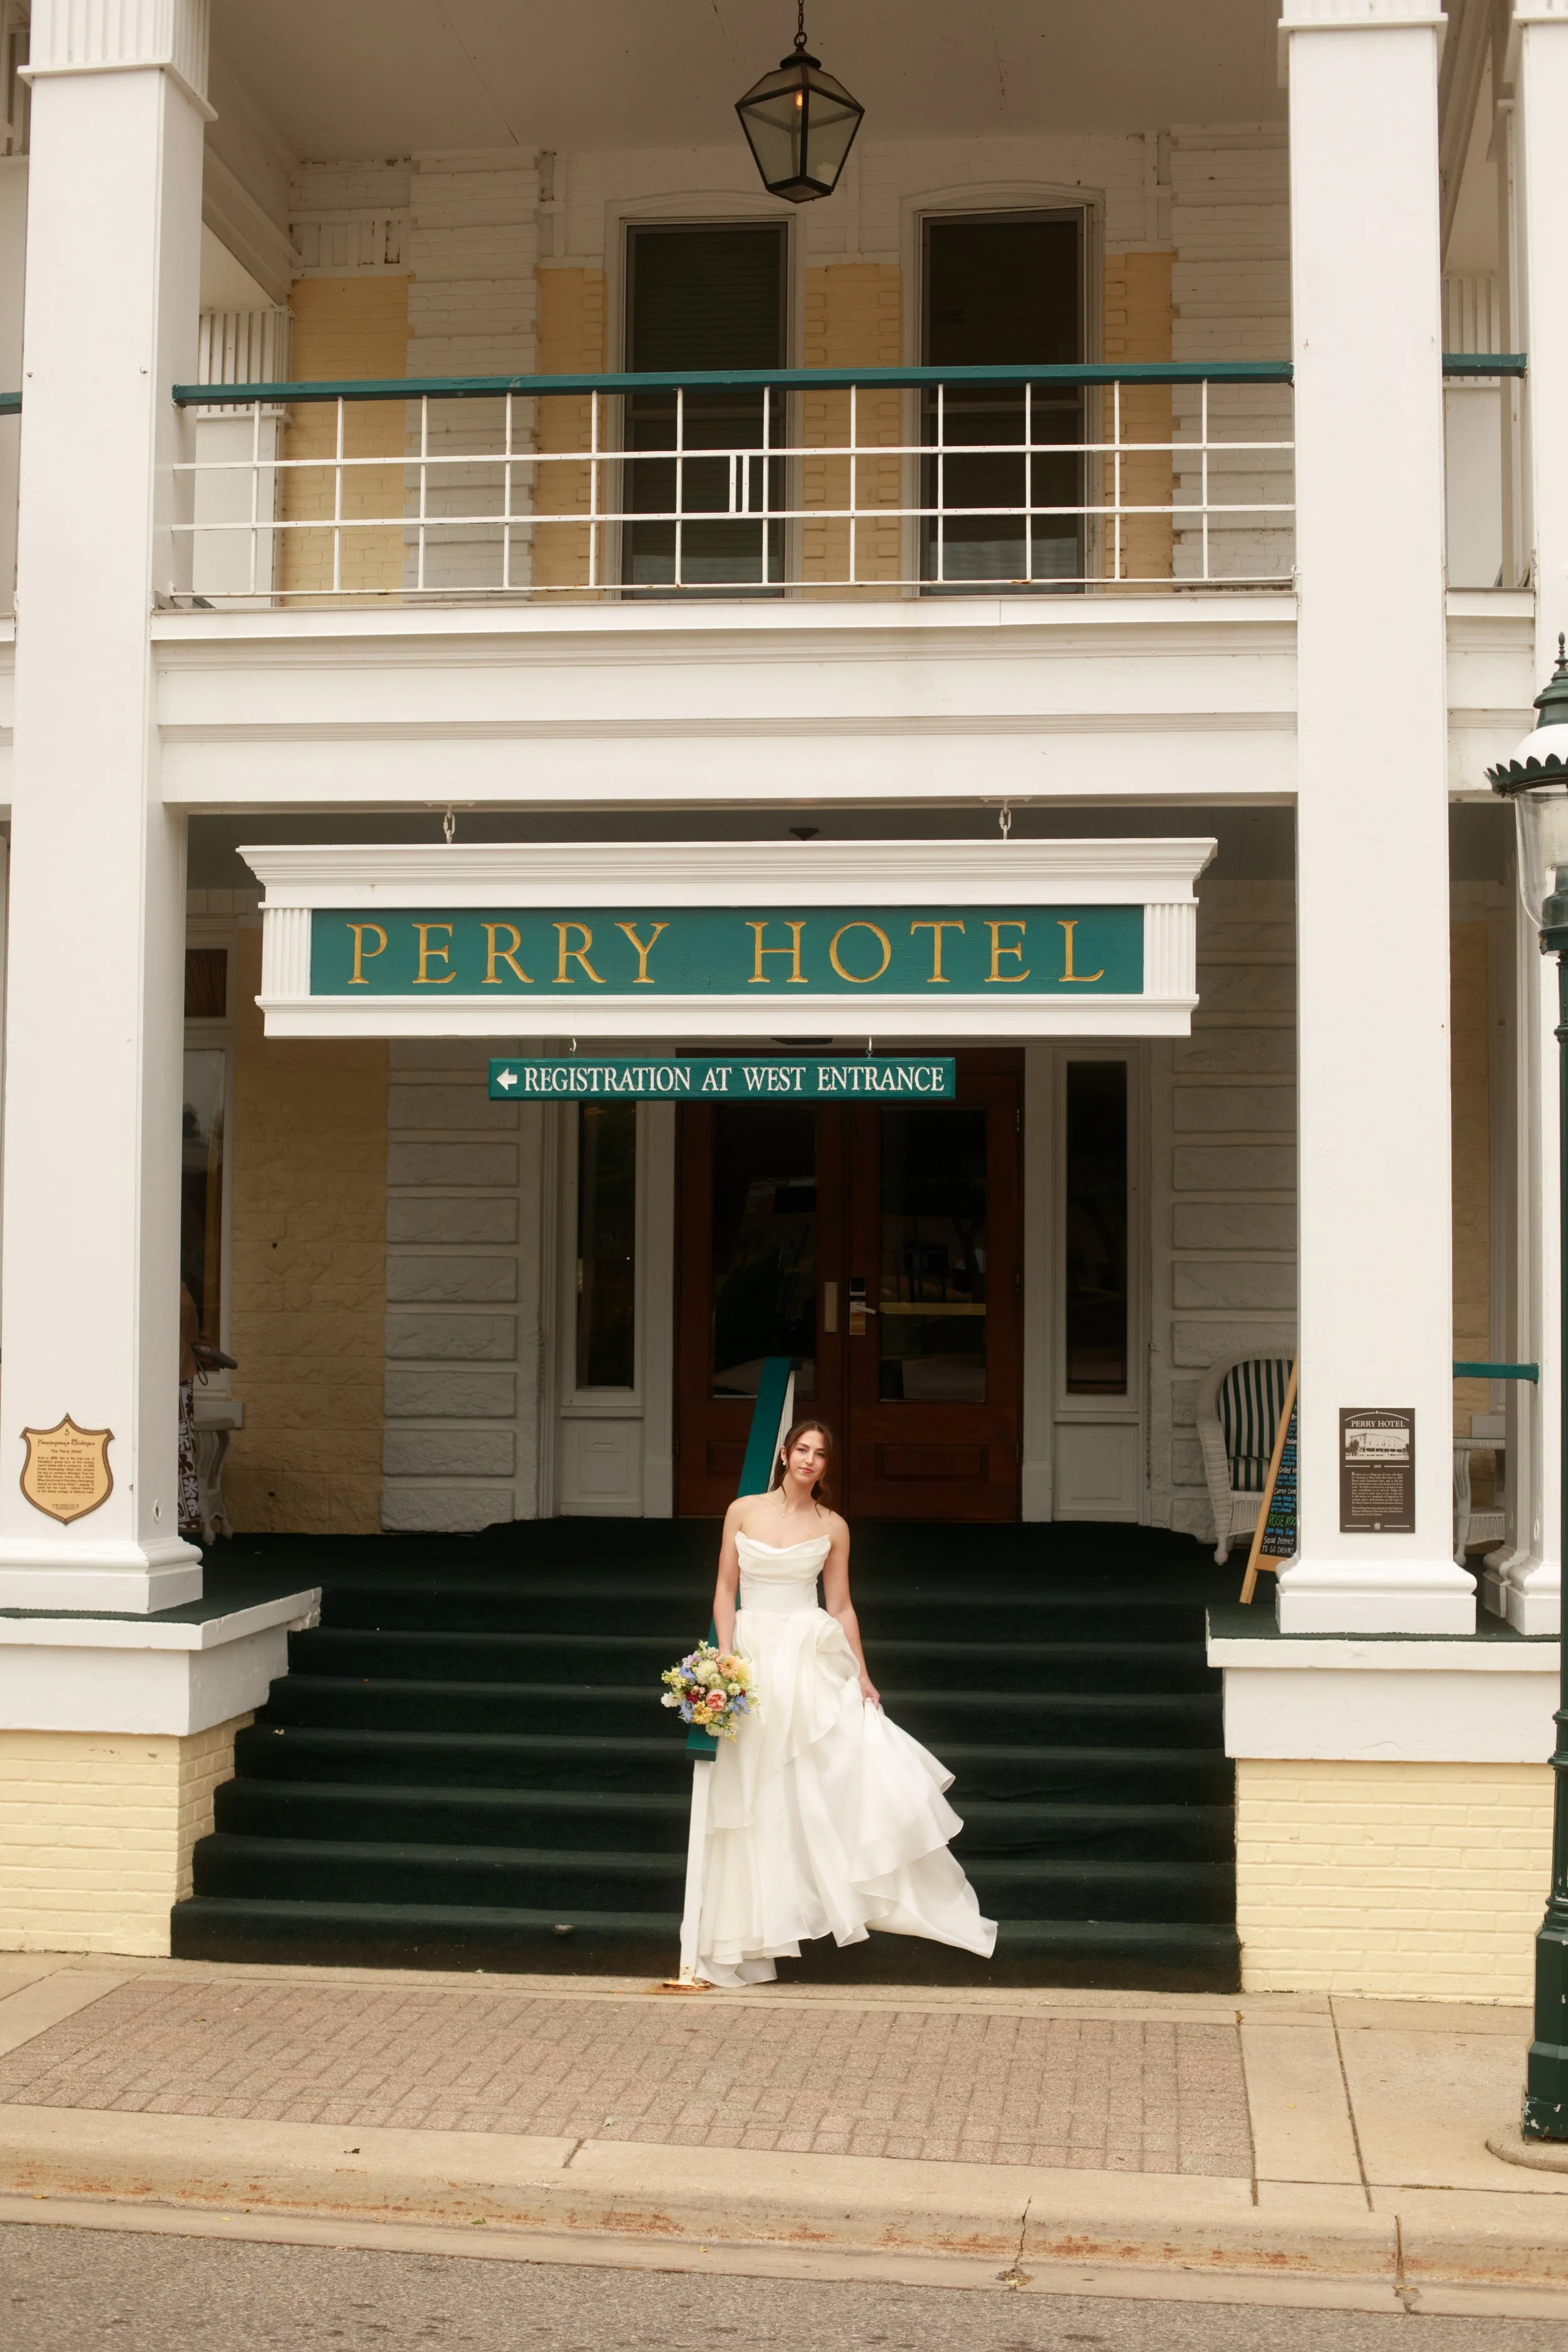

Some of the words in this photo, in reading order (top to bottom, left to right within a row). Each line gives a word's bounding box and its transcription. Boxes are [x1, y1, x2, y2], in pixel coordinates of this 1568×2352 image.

[346, 922, 670, 984] PERRY
[745, 920, 1104, 983] HOTEL
[524, 1067, 691, 1092] REGISTRATION
[701, 1067, 732, 1092] AT
[742, 1067, 806, 1092] WEST
[817, 1066, 945, 1092] ENTRANCE
[1268, 1514, 1285, 1527] ROSE
[1264, 1536, 1276, 1544] Social
[1277, 1537, 1295, 1545] District
[1262, 1545, 1268, 1553] TO
[1269, 1545, 1276, 1554] GO
[1277, 1546, 1294, 1555] DRINKS
